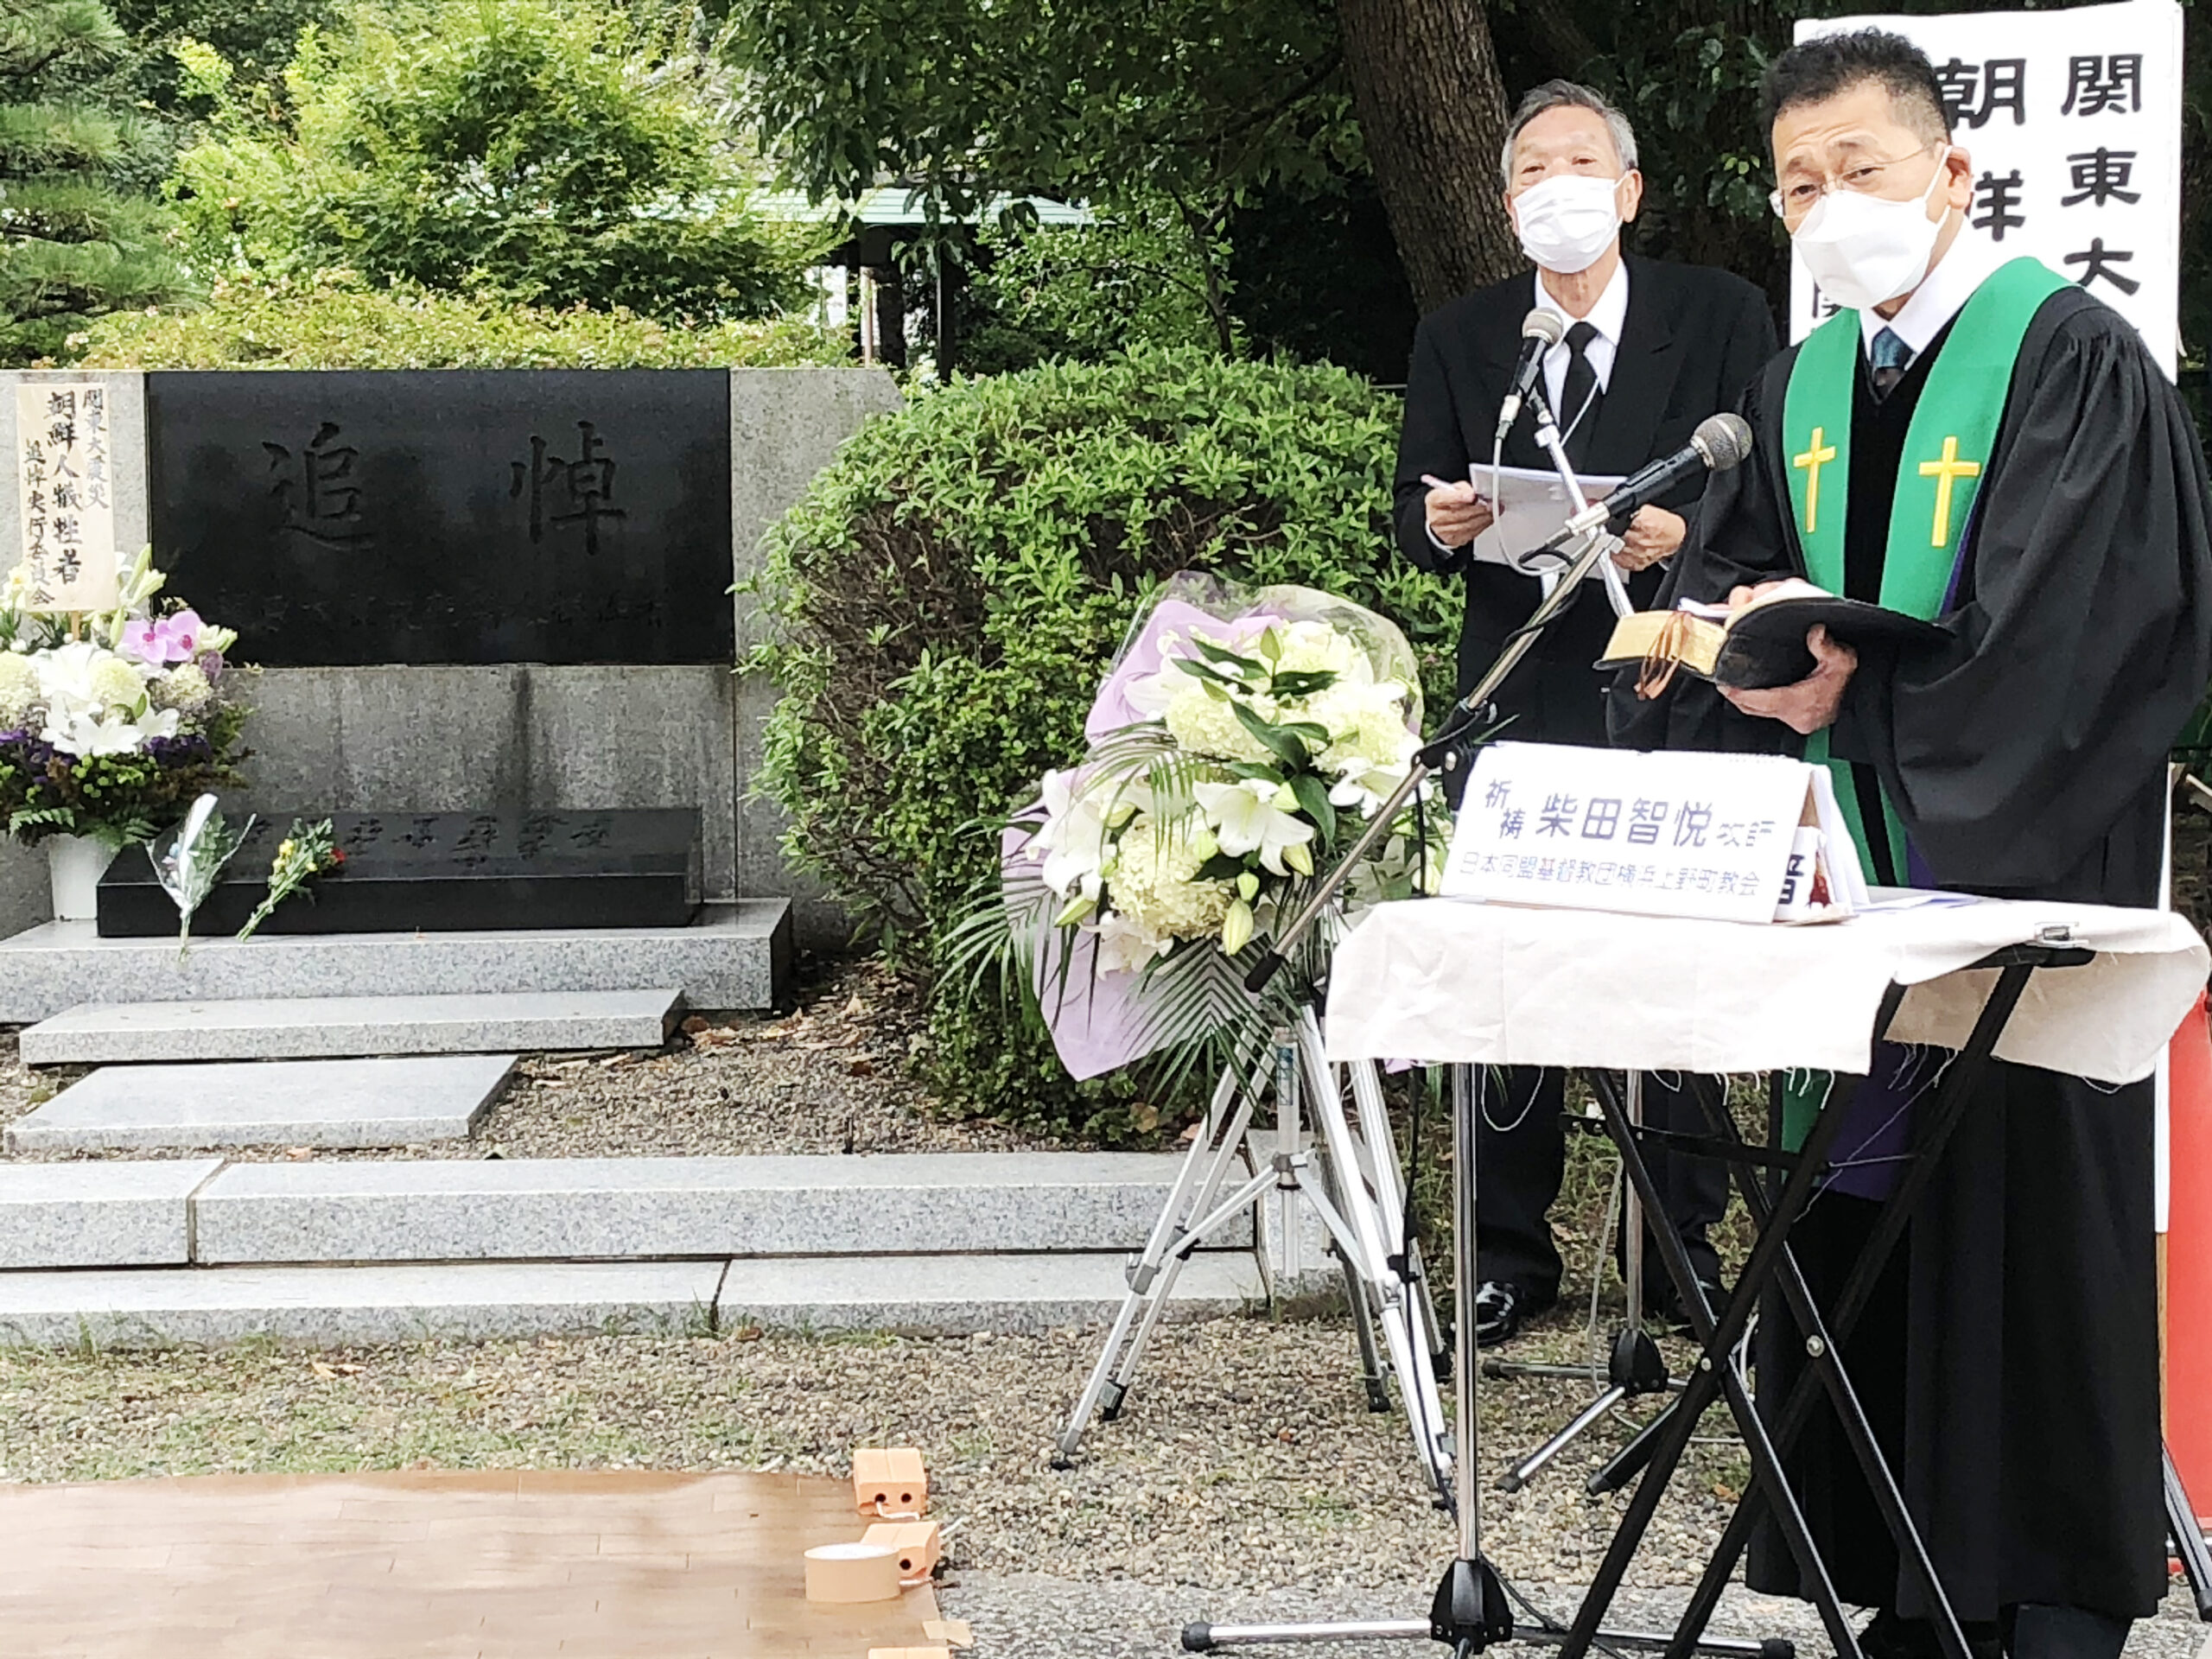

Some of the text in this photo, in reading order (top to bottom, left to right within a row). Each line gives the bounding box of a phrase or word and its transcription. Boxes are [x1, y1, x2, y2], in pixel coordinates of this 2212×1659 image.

[2061, 54, 2144, 297] 関東大
[261, 420, 627, 556] 追悼
